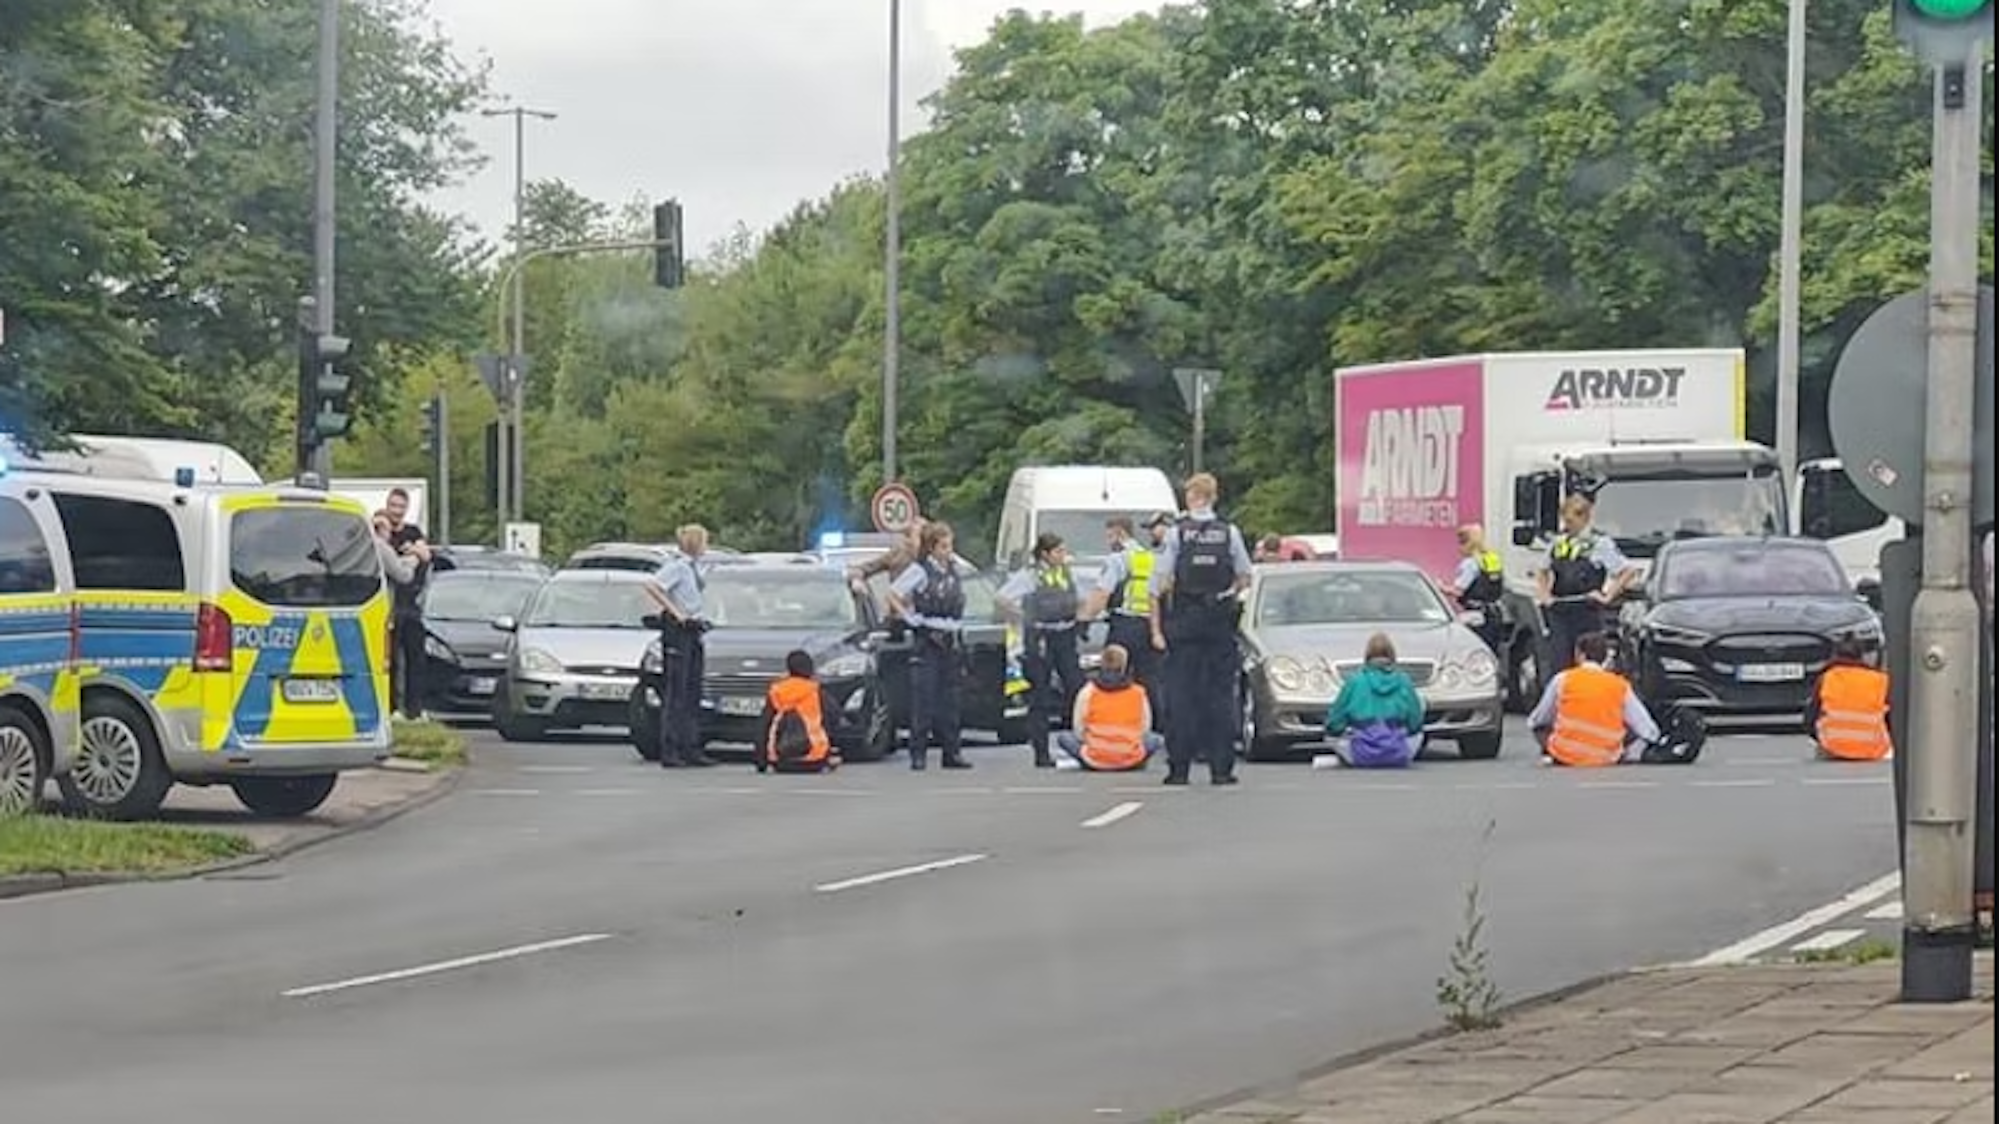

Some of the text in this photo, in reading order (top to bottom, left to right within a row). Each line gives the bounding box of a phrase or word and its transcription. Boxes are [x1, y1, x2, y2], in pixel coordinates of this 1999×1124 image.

[1545, 367, 1685, 409] ARNDT
[1359, 405, 1464, 523] ARNDT
[884, 499, 907, 522] 50
[234, 626, 299, 649] POLIZEI
